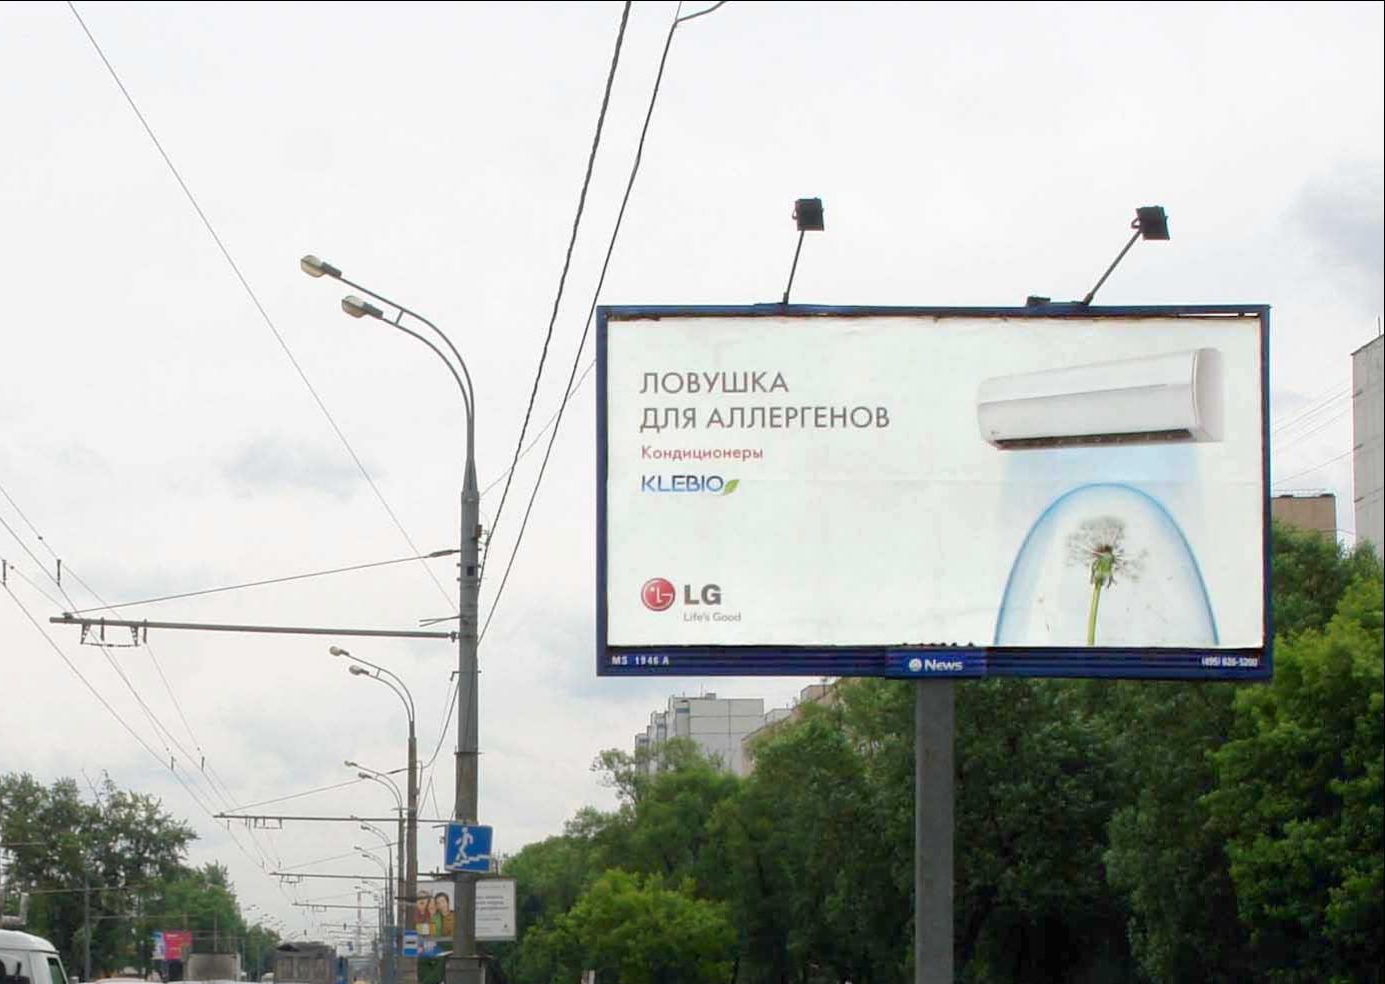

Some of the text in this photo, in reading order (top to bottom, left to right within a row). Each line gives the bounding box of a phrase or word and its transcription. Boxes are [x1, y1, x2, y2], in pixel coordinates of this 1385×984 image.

[642, 372, 788, 394] ЛОВУШКА
[640, 406, 890, 433] ДЛЯ АЛЛЕРГЕНОВ
[641, 444, 764, 463] Кондиционеры
[641, 474, 724, 493] KLEBIO
[684, 583, 722, 606] LG
[683, 611, 742, 622] Life's Good
[924, 658, 963, 671] News
